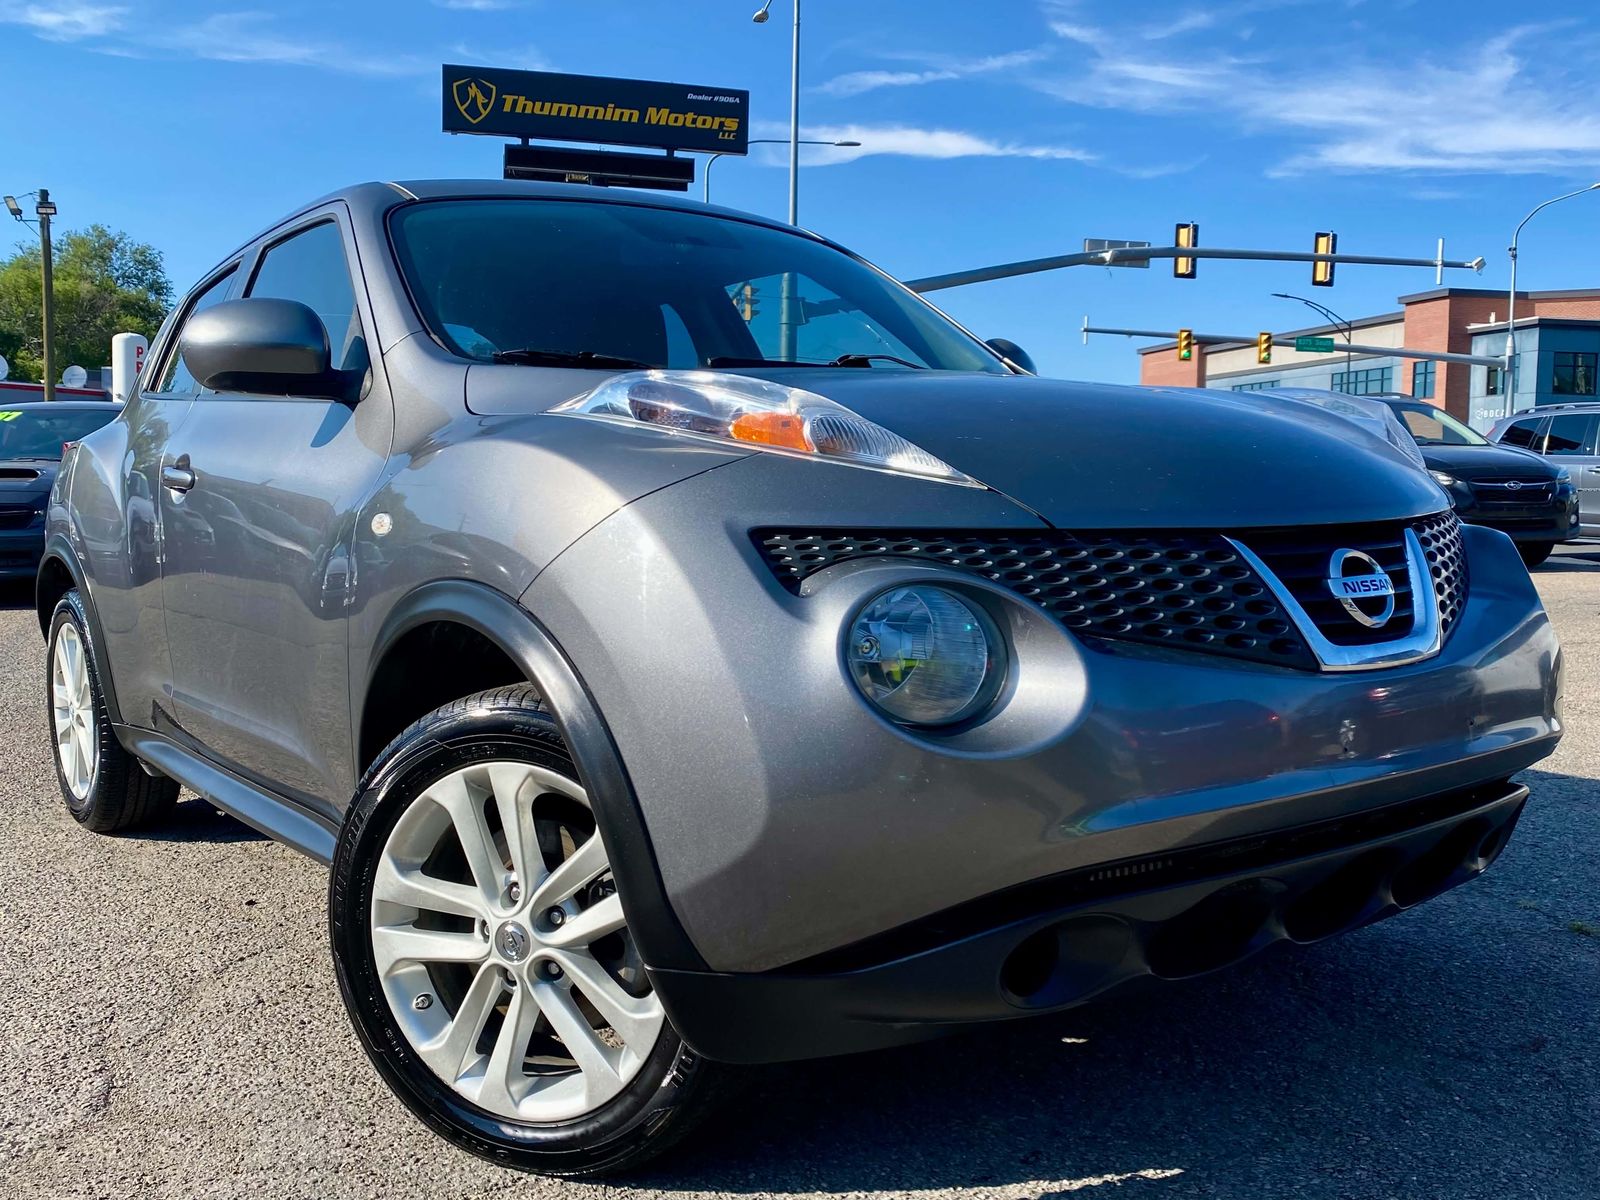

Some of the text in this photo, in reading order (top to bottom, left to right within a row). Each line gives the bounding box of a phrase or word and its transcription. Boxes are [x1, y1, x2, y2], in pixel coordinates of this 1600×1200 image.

[687, 93, 713, 101] Dealer
[501, 94, 740, 132] Thummim Motors
[718, 131, 737, 140] LLC
[1341, 578, 1392, 594] NISSAN
